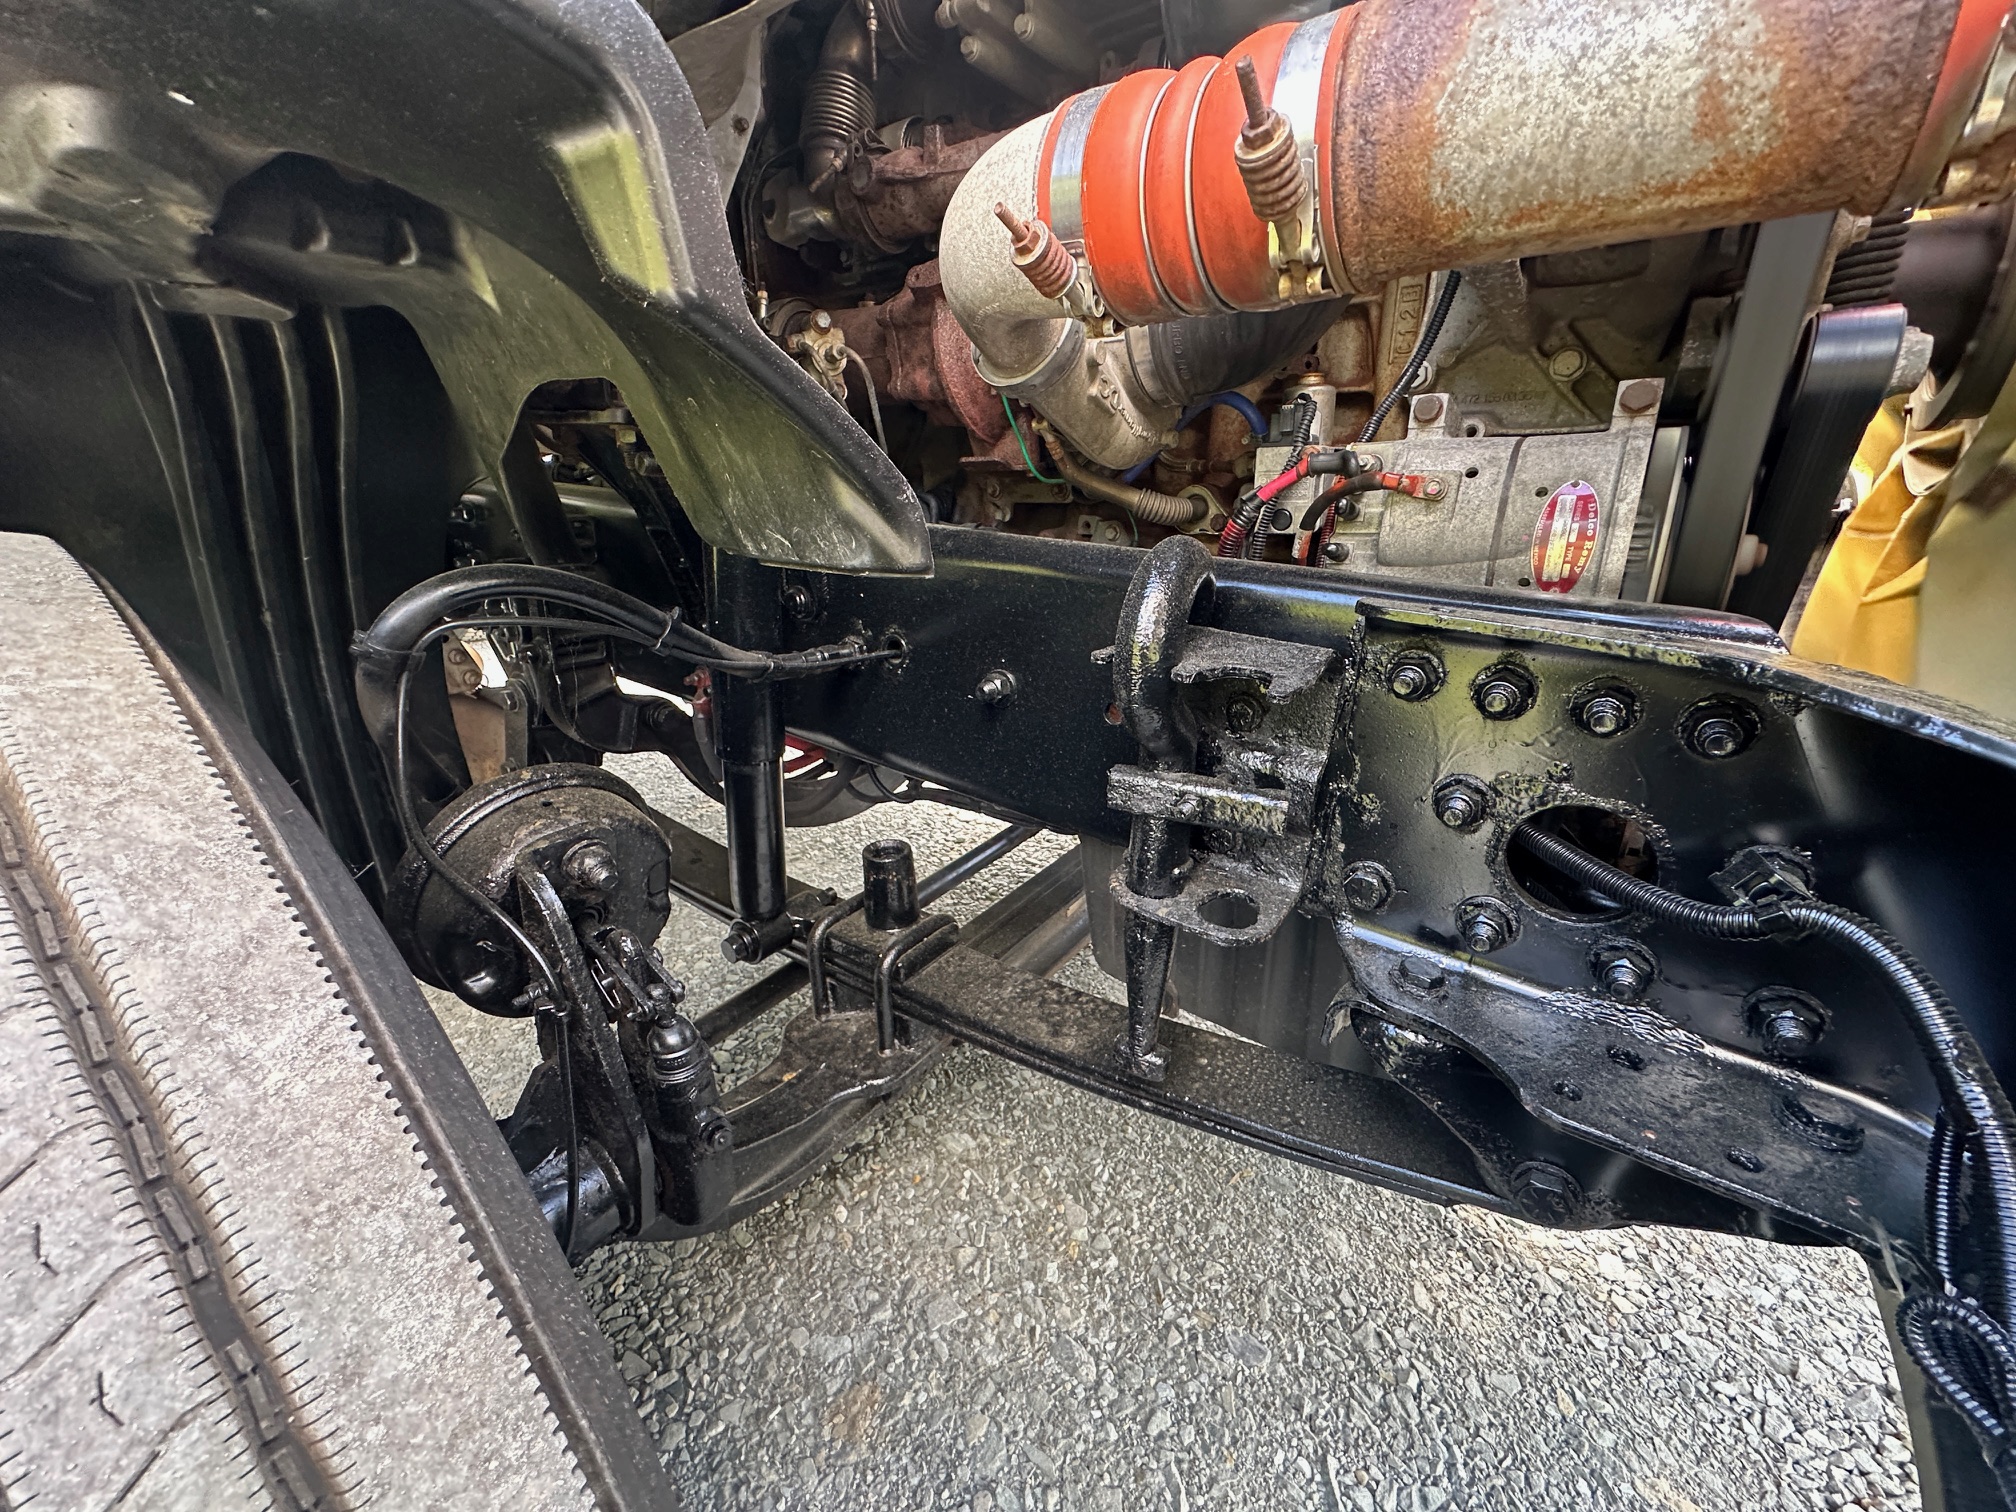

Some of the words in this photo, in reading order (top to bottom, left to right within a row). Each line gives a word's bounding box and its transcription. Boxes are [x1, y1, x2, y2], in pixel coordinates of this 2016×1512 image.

[1536, 507, 1551, 538] ASSEMBLED
[1573, 500, 1584, 522] SERIES
[1587, 502, 1598, 537] Delco
[1565, 546, 1574, 562] TYPE
[1574, 540, 1594, 574] Remy
